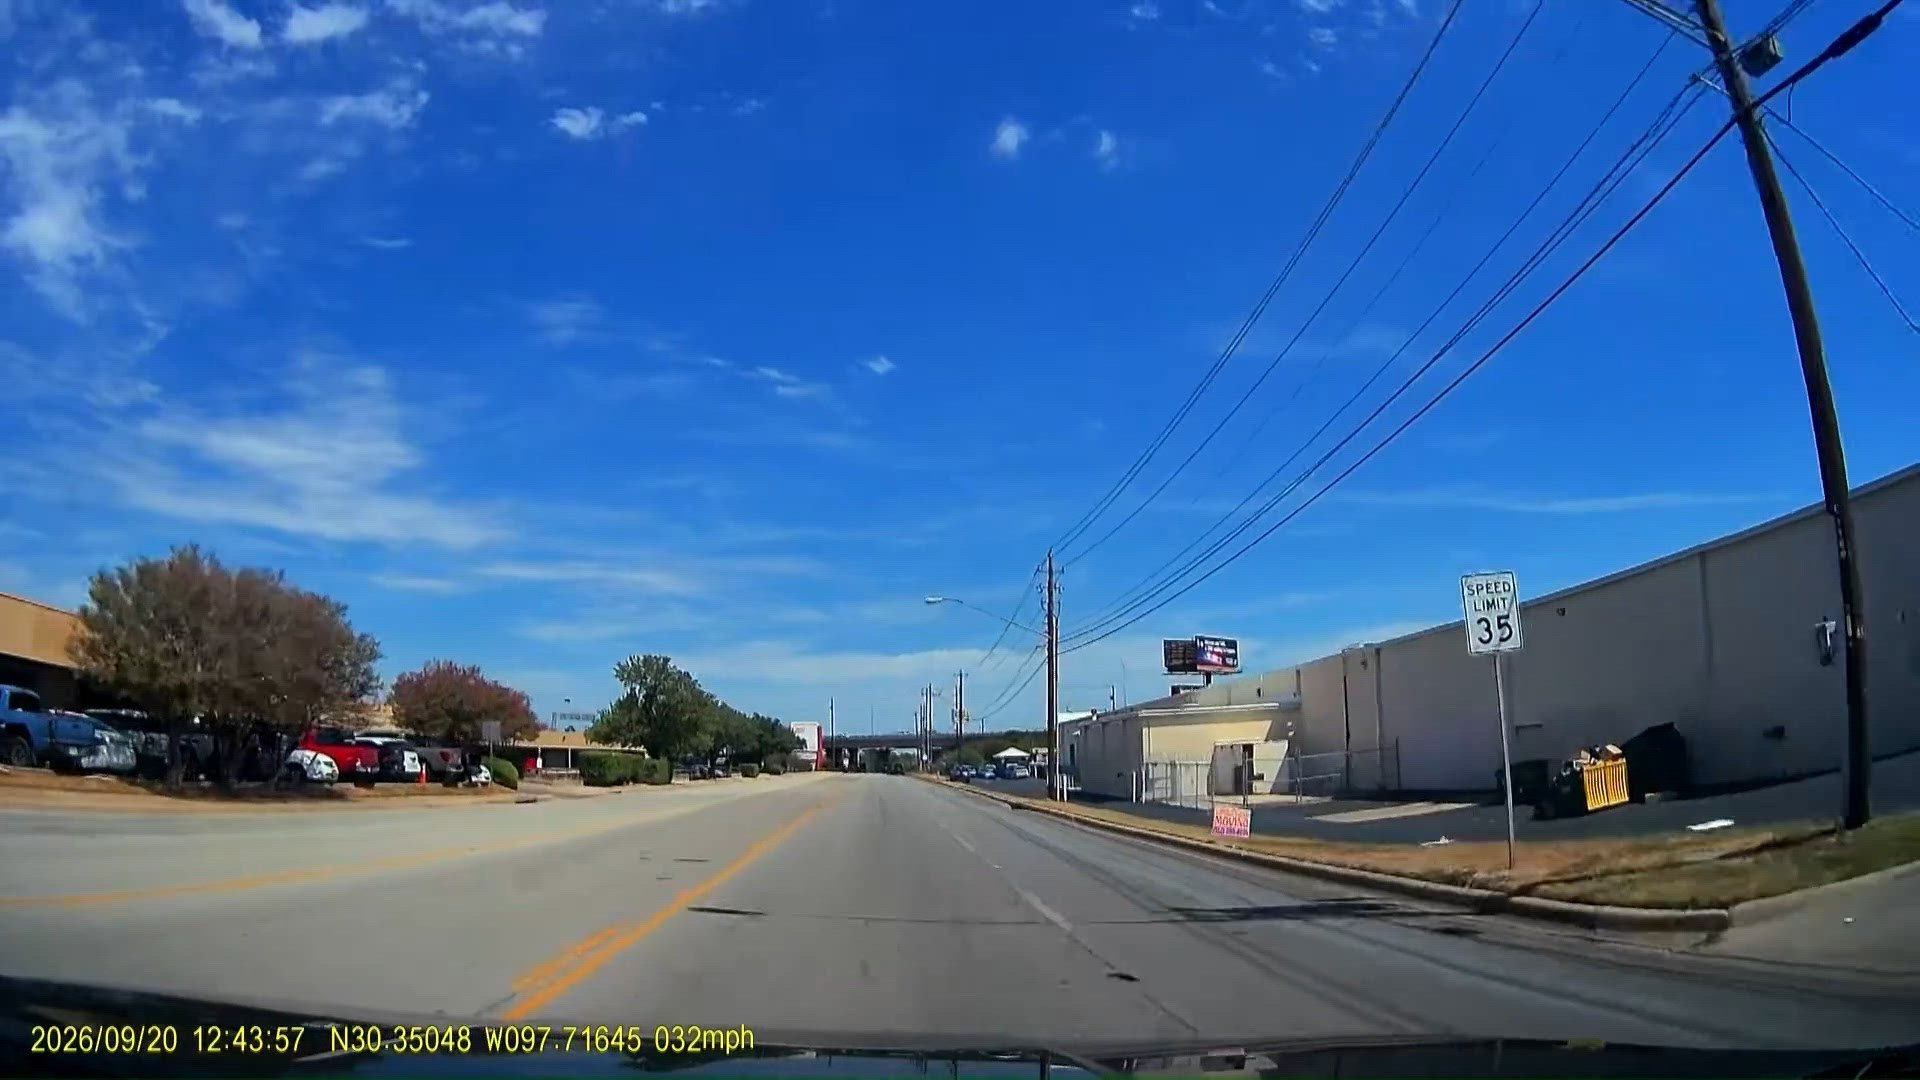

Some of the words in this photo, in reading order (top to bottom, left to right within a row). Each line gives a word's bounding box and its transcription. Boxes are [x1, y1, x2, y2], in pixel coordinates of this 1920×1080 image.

[1466, 581, 1511, 596] SPEED
[1473, 597, 1507, 612] LIMIT
[1476, 613, 1514, 645] 35
[1215, 815, 1250, 828] MOVING
